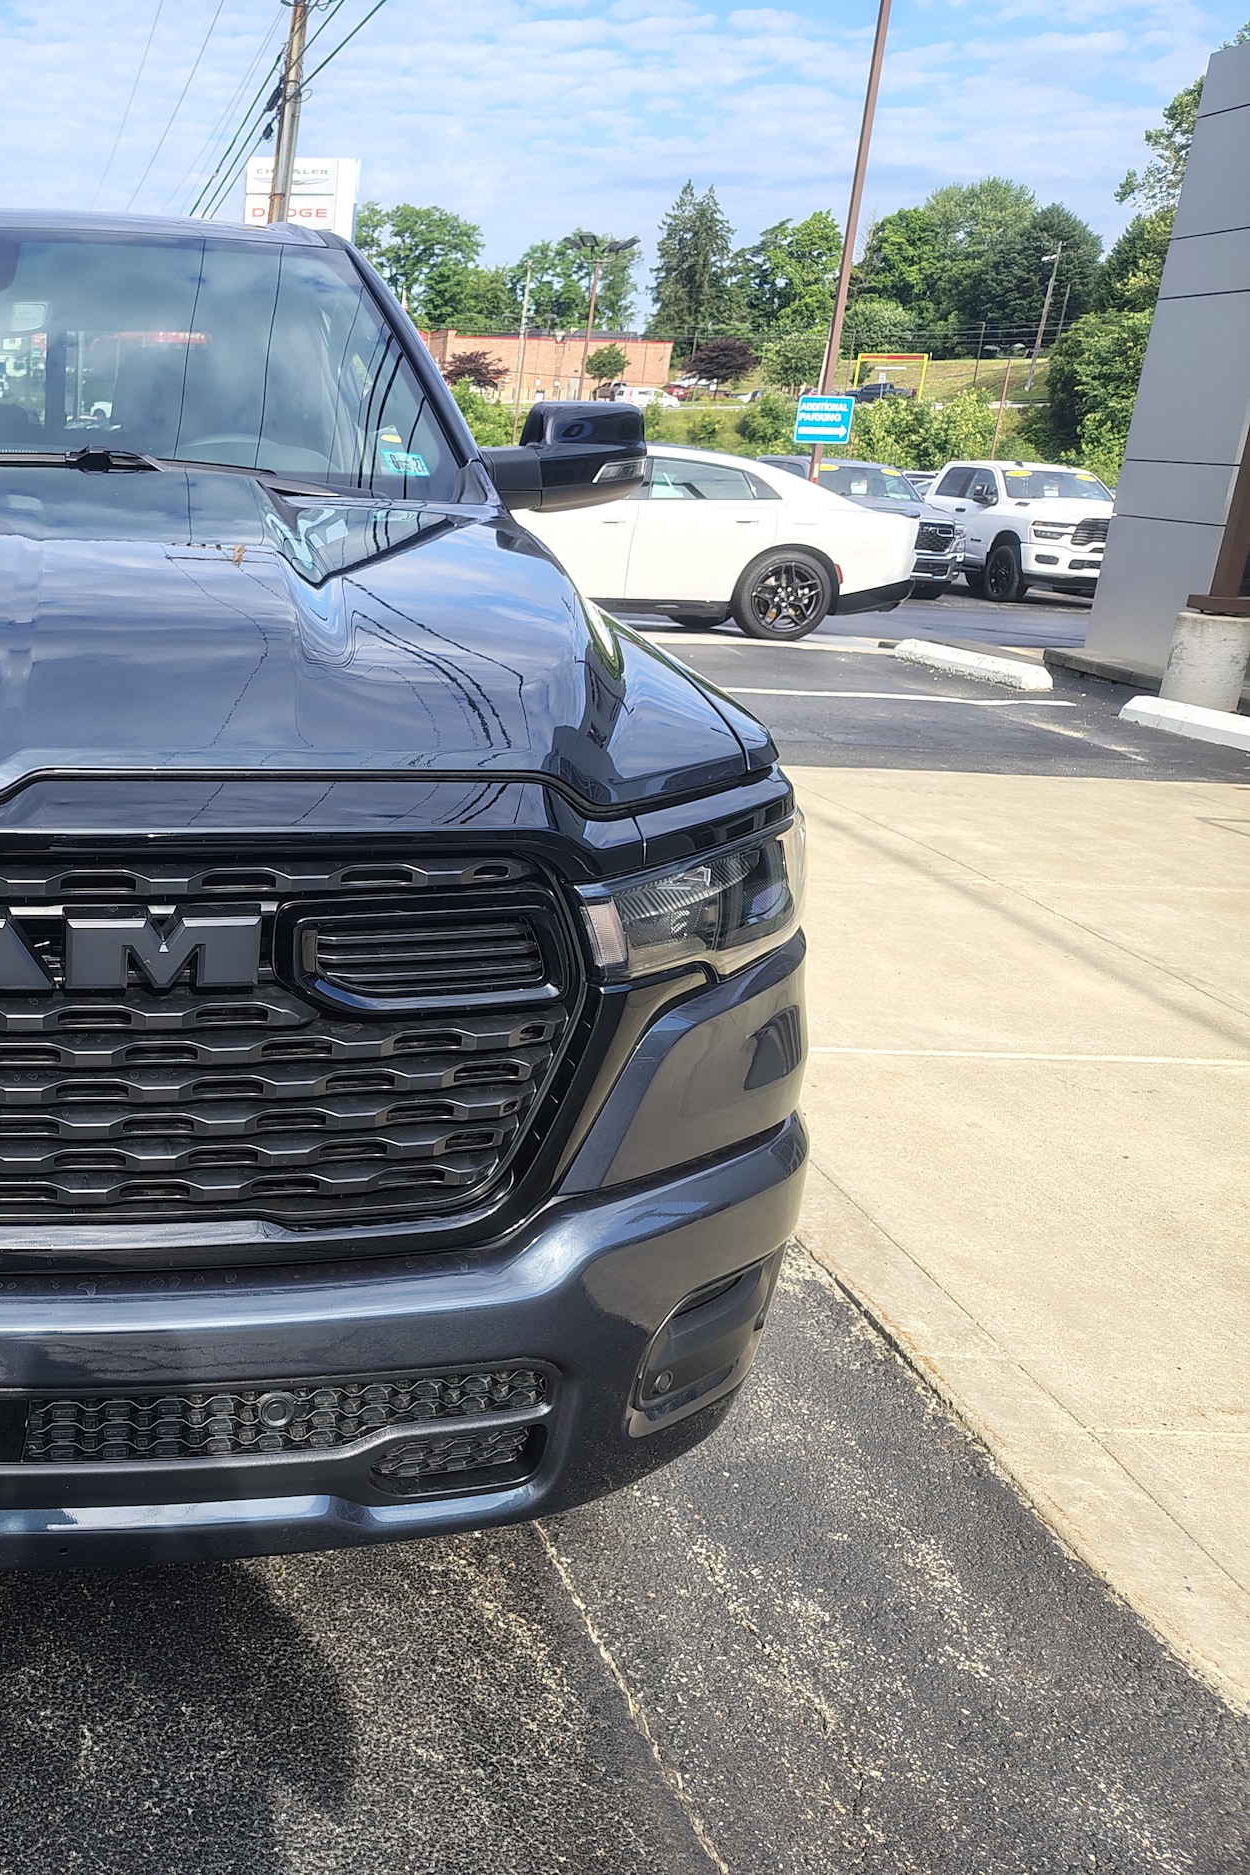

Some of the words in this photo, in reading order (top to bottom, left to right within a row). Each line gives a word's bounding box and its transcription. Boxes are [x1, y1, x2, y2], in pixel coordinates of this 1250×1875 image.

[251, 207, 328, 218] DDGE
[800, 402, 849, 412] ADDITIONAL
[798, 412, 842, 422] PARKING
